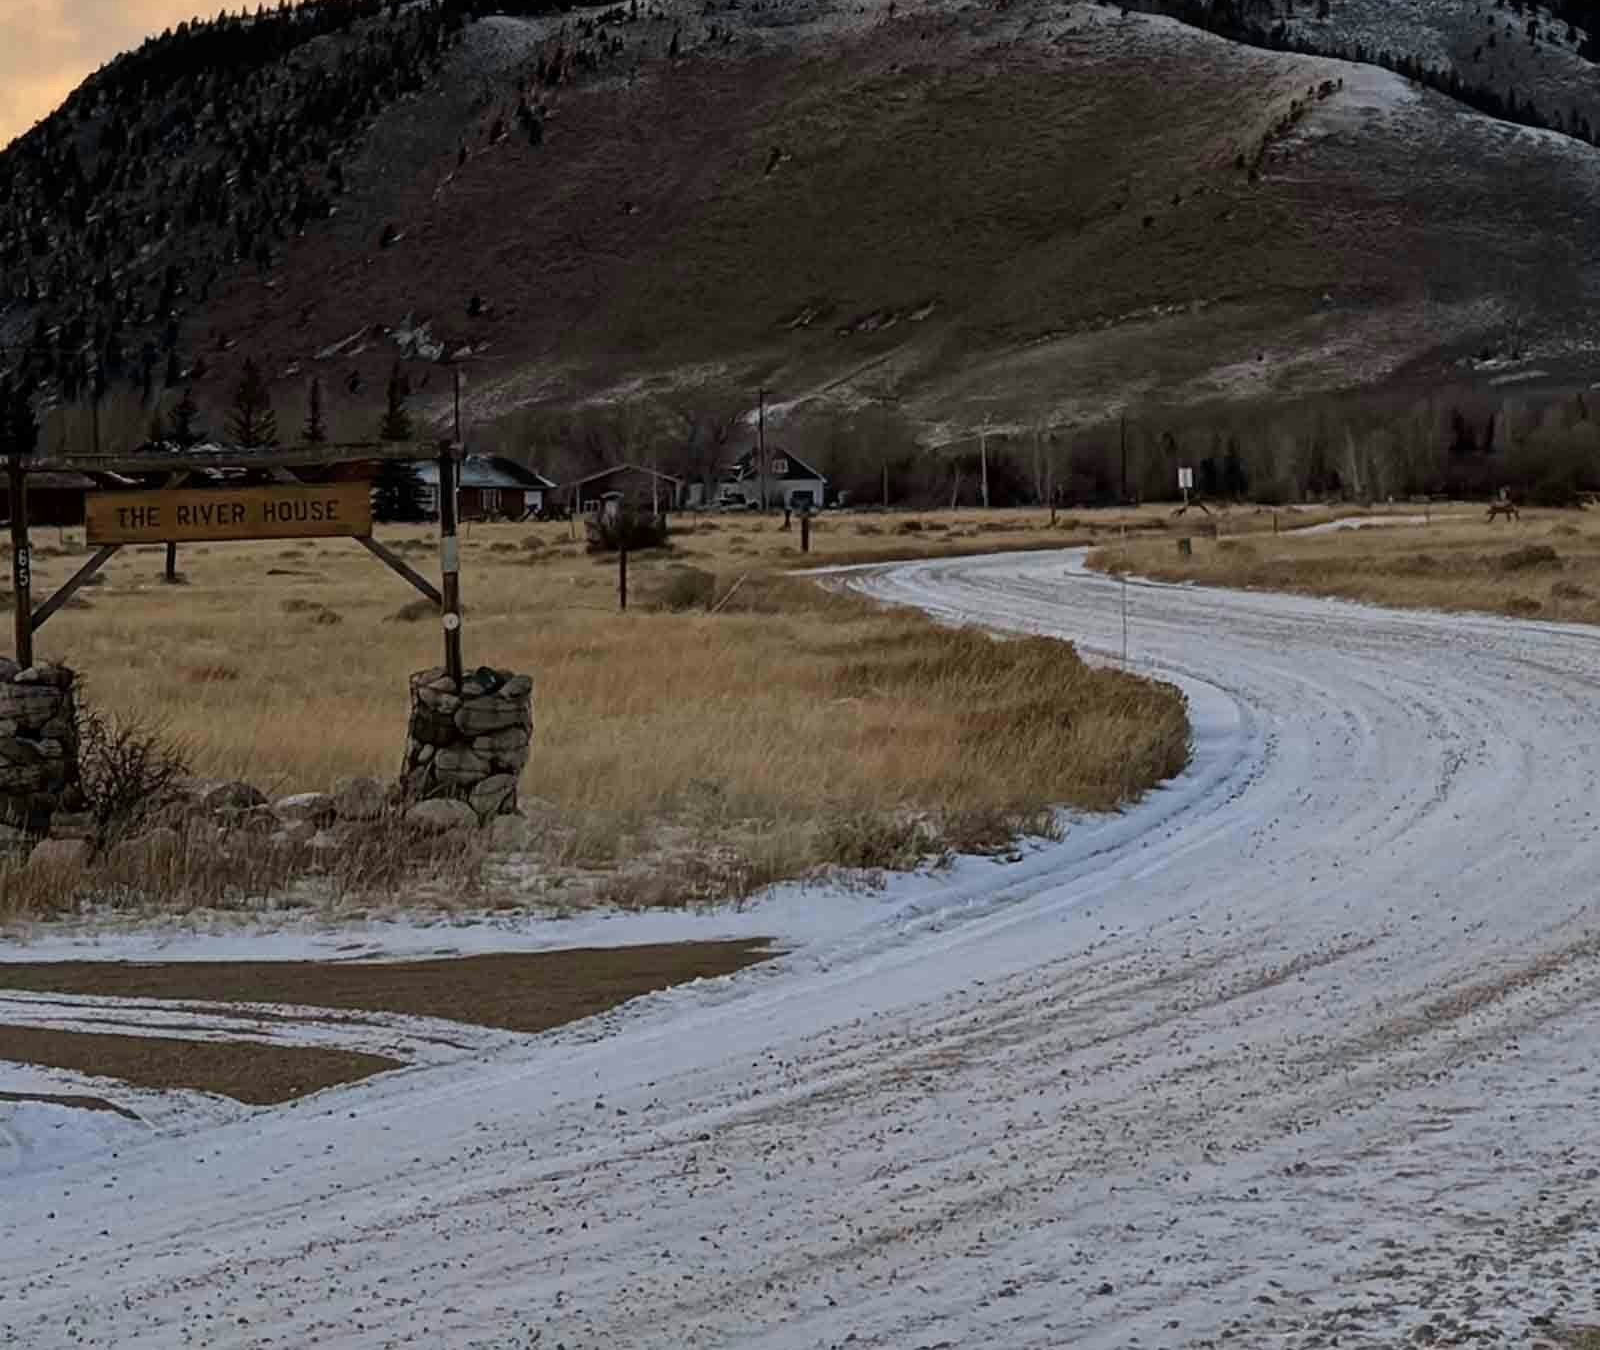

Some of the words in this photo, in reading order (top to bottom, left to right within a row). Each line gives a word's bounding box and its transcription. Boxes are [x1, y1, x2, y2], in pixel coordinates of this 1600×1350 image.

[117, 506, 161, 529] THE
[177, 503, 246, 525] RIVER
[263, 499, 340, 522] HOUSE
